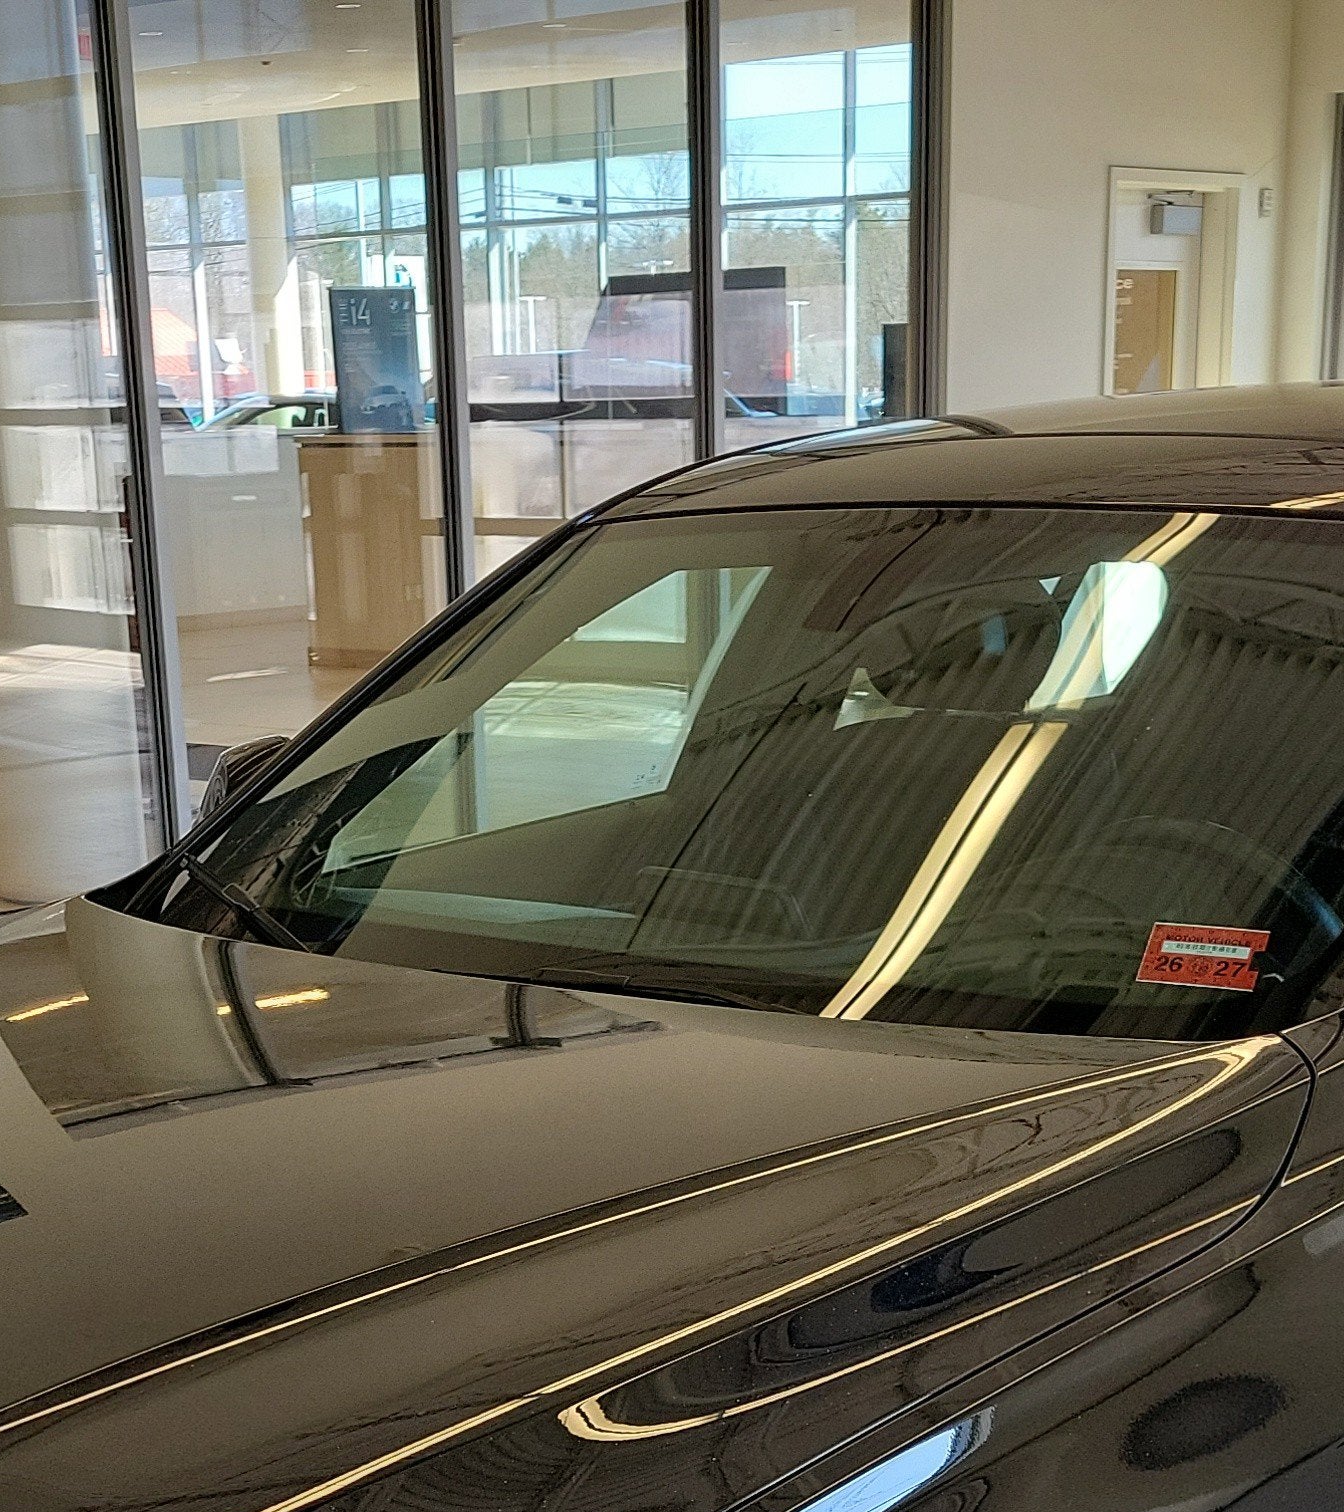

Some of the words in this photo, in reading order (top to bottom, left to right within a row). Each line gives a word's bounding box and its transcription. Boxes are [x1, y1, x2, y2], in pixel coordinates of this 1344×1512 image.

[350, 298, 371, 326] i4
[1154, 955, 1184, 973] 26
[1212, 960, 1248, 978] 27
